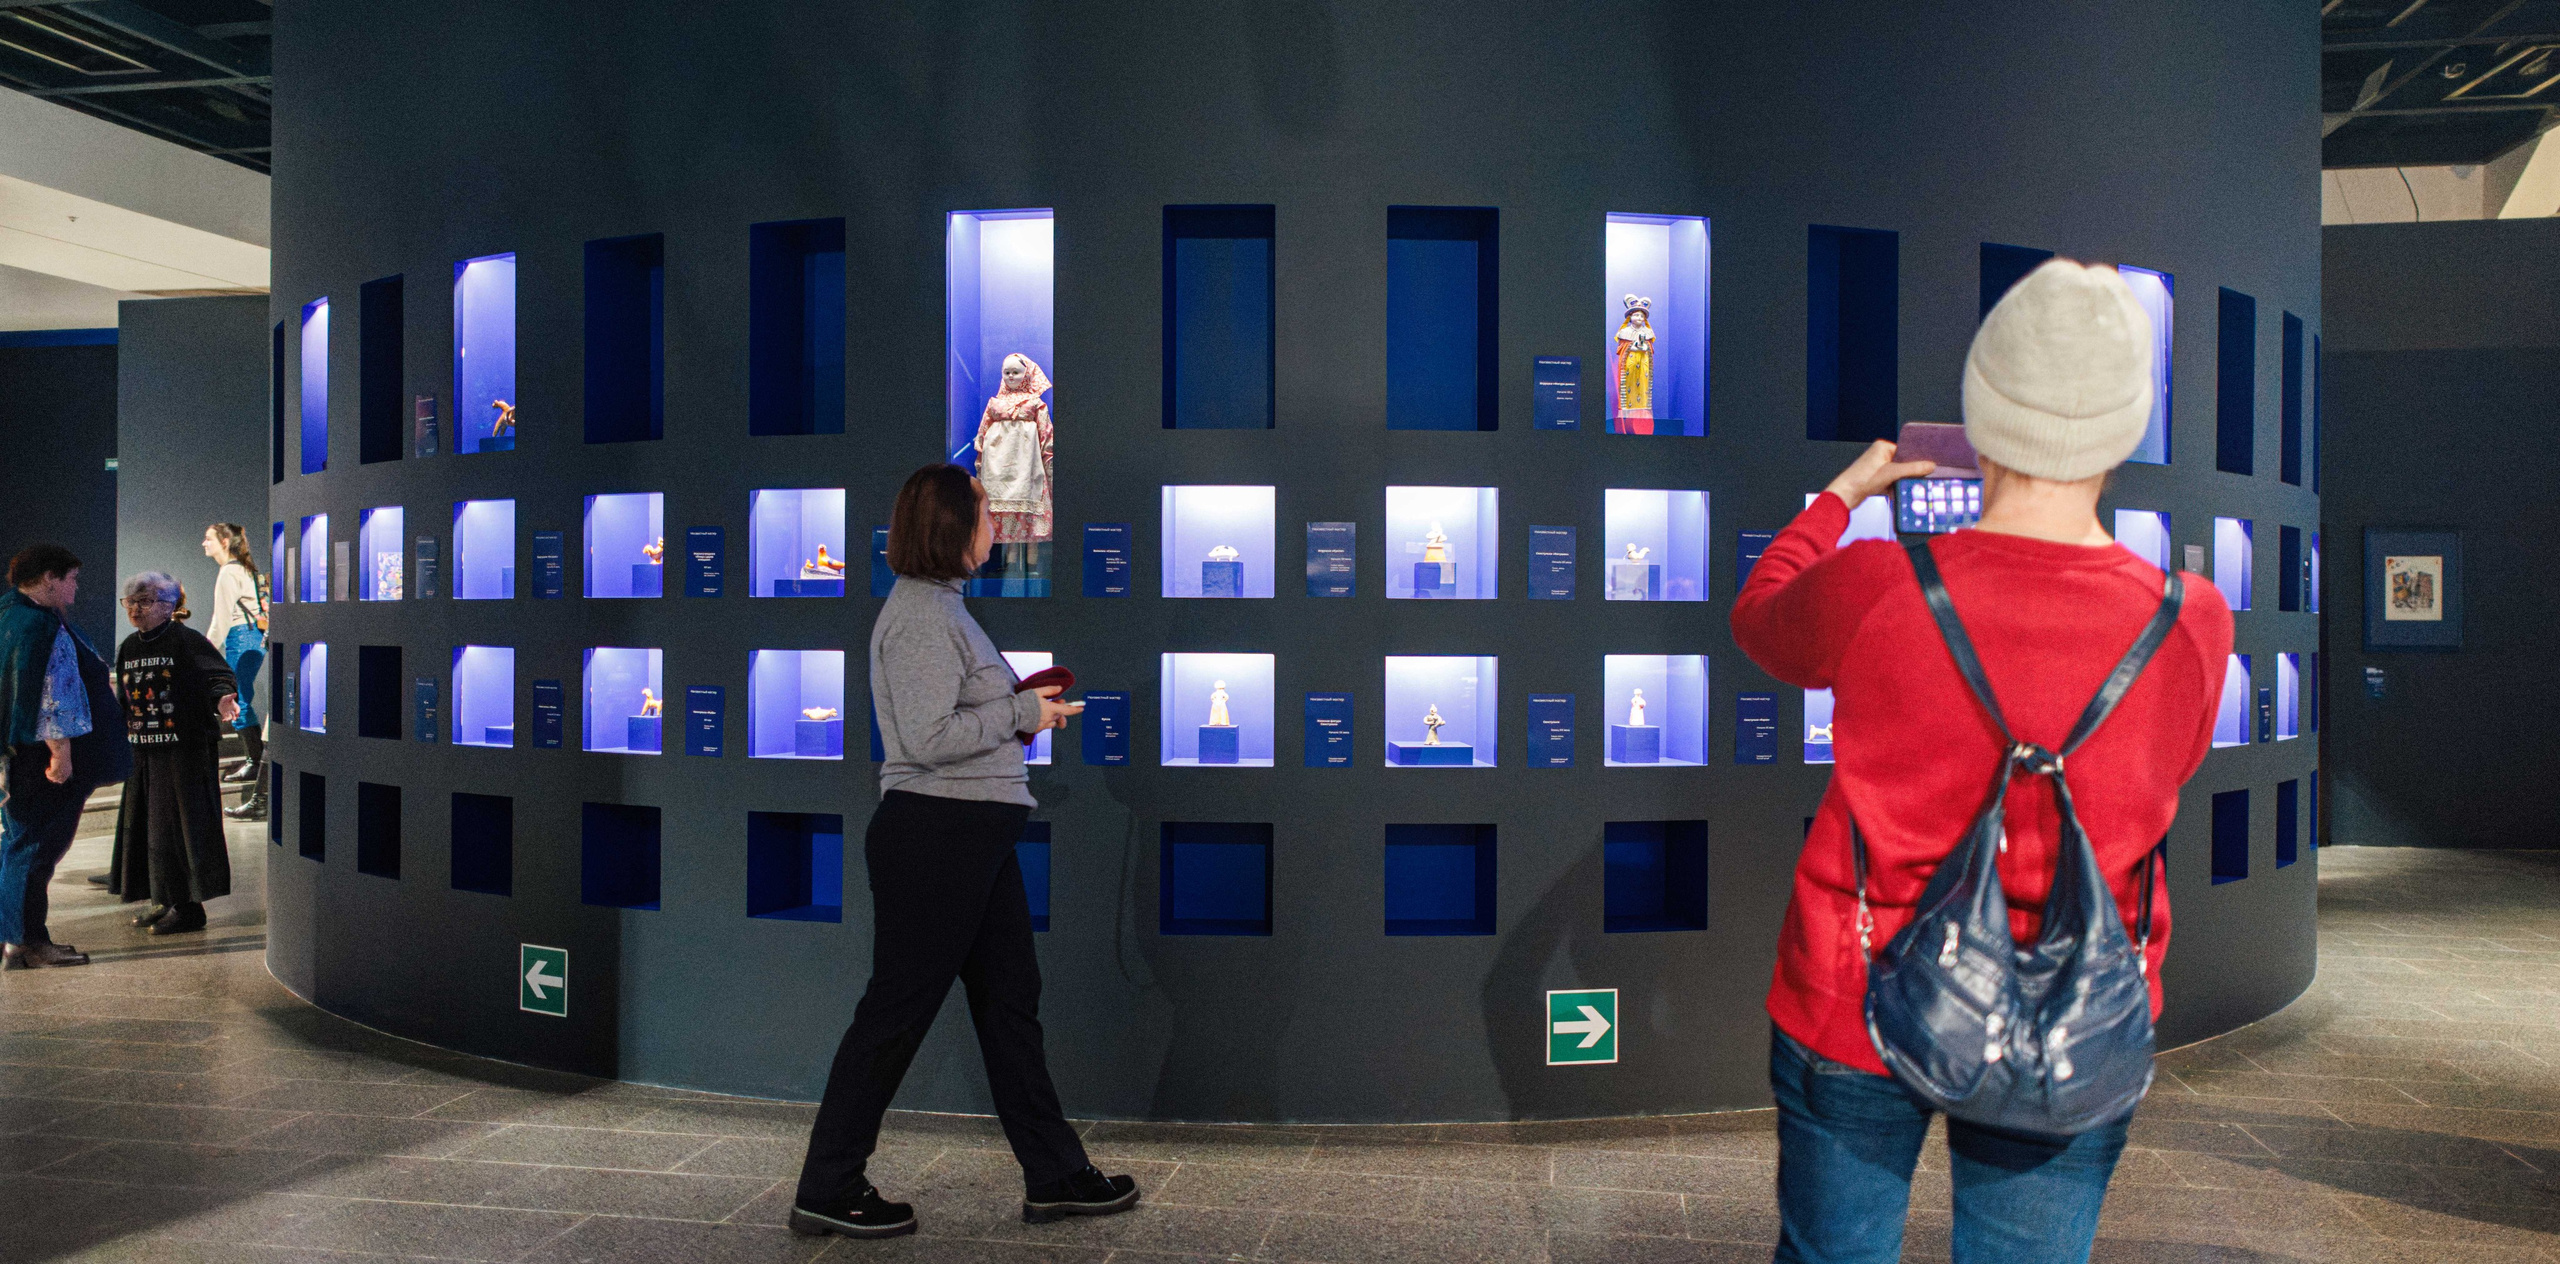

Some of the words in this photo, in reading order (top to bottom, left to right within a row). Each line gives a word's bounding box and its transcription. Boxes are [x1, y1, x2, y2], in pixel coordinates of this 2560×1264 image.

[124, 659, 139, 670] ВСЕ
[141, 657, 175, 667] БЕНУА
[140, 733, 179, 744] БЕНУА
